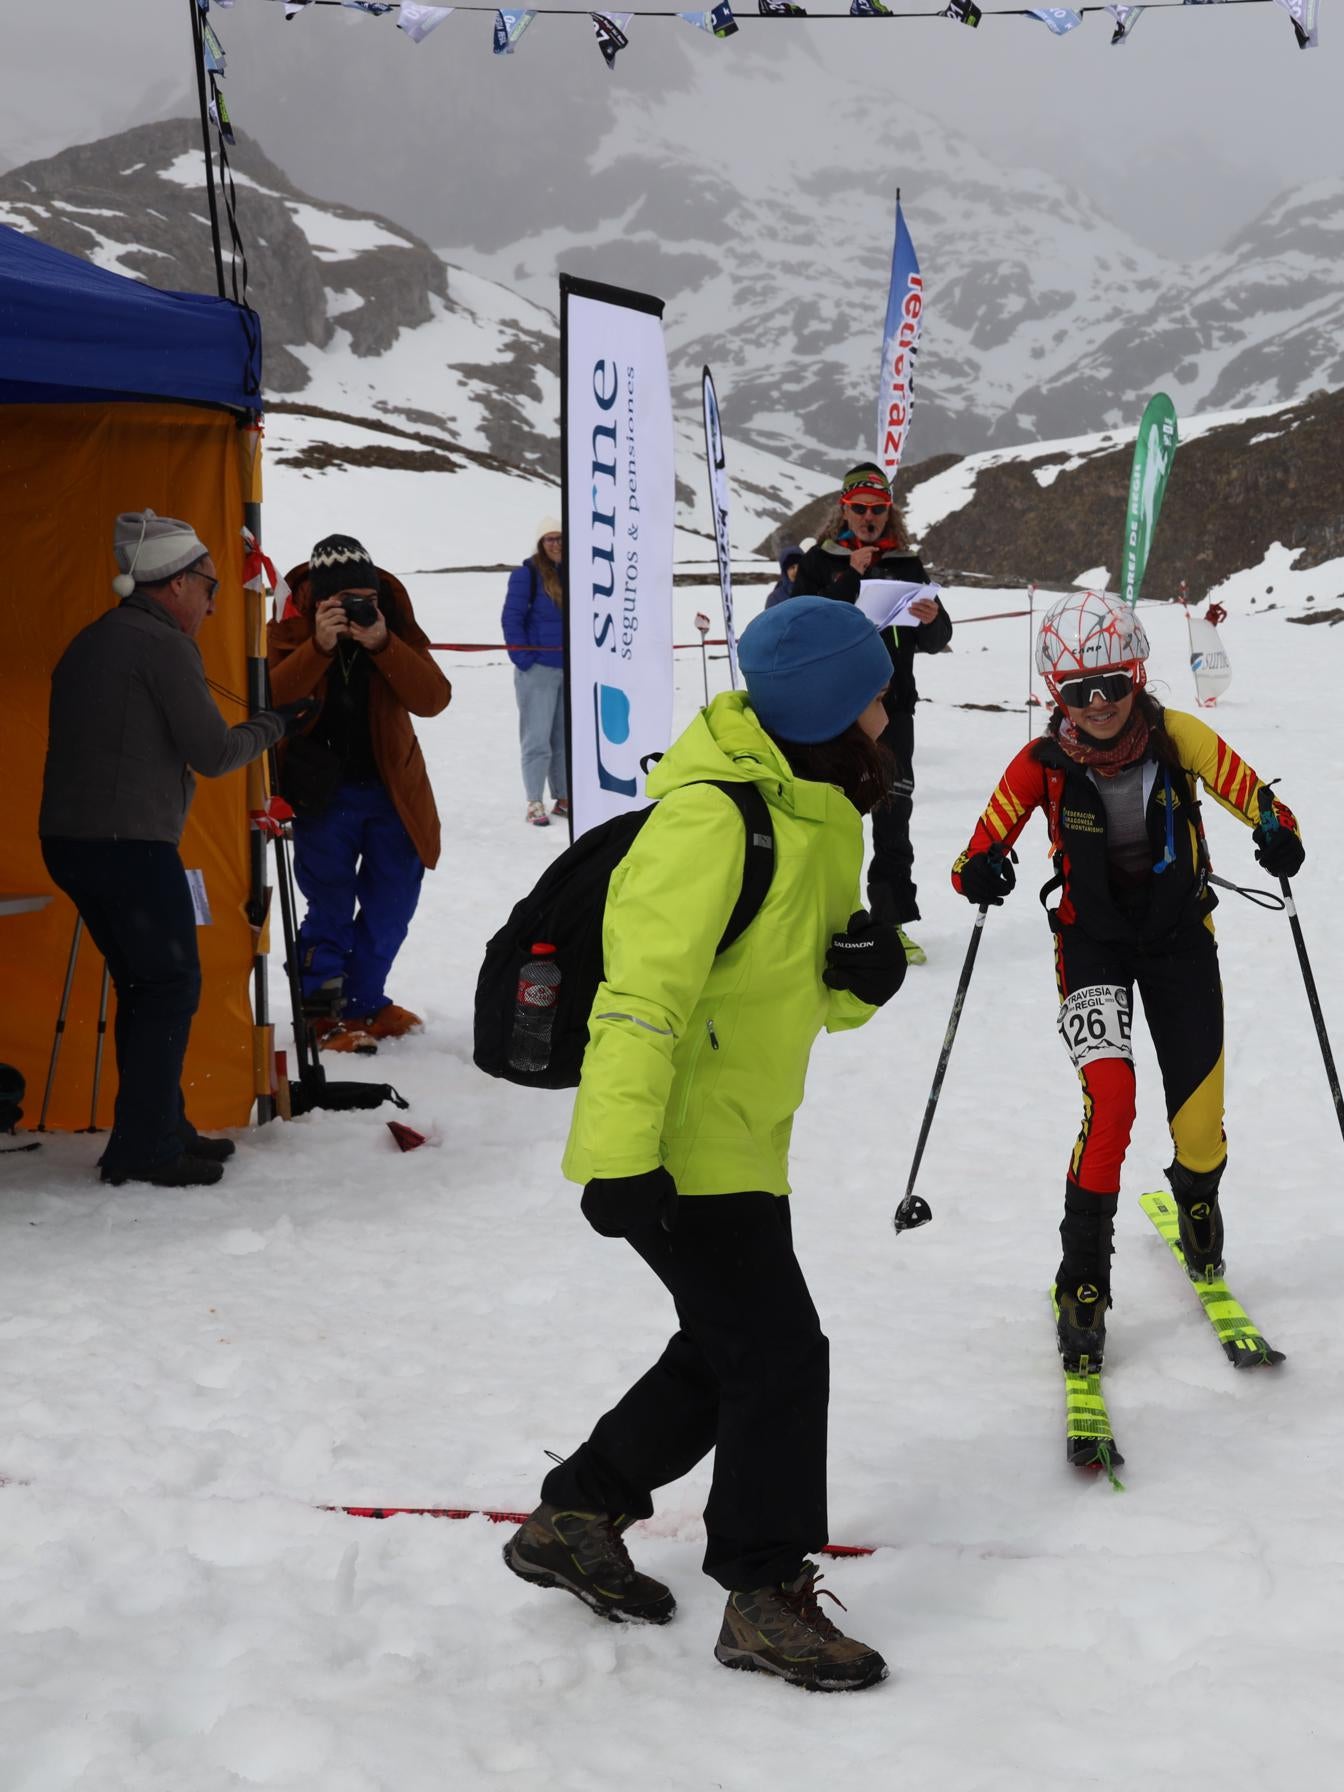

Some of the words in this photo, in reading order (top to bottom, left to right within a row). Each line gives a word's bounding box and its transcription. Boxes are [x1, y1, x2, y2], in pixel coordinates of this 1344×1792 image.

[625, 366, 638, 513] pensiones
[591, 358, 619, 654] surne
[626, 524, 639, 539] &
[620, 552, 639, 660] seguros
[1072, 645, 1102, 655] CAMP
[834, 941, 874, 949] SALOMON
[1074, 997, 1105, 1011] REGIL
[1059, 1008, 1106, 1051] 126
[1117, 1010, 1131, 1040] B
